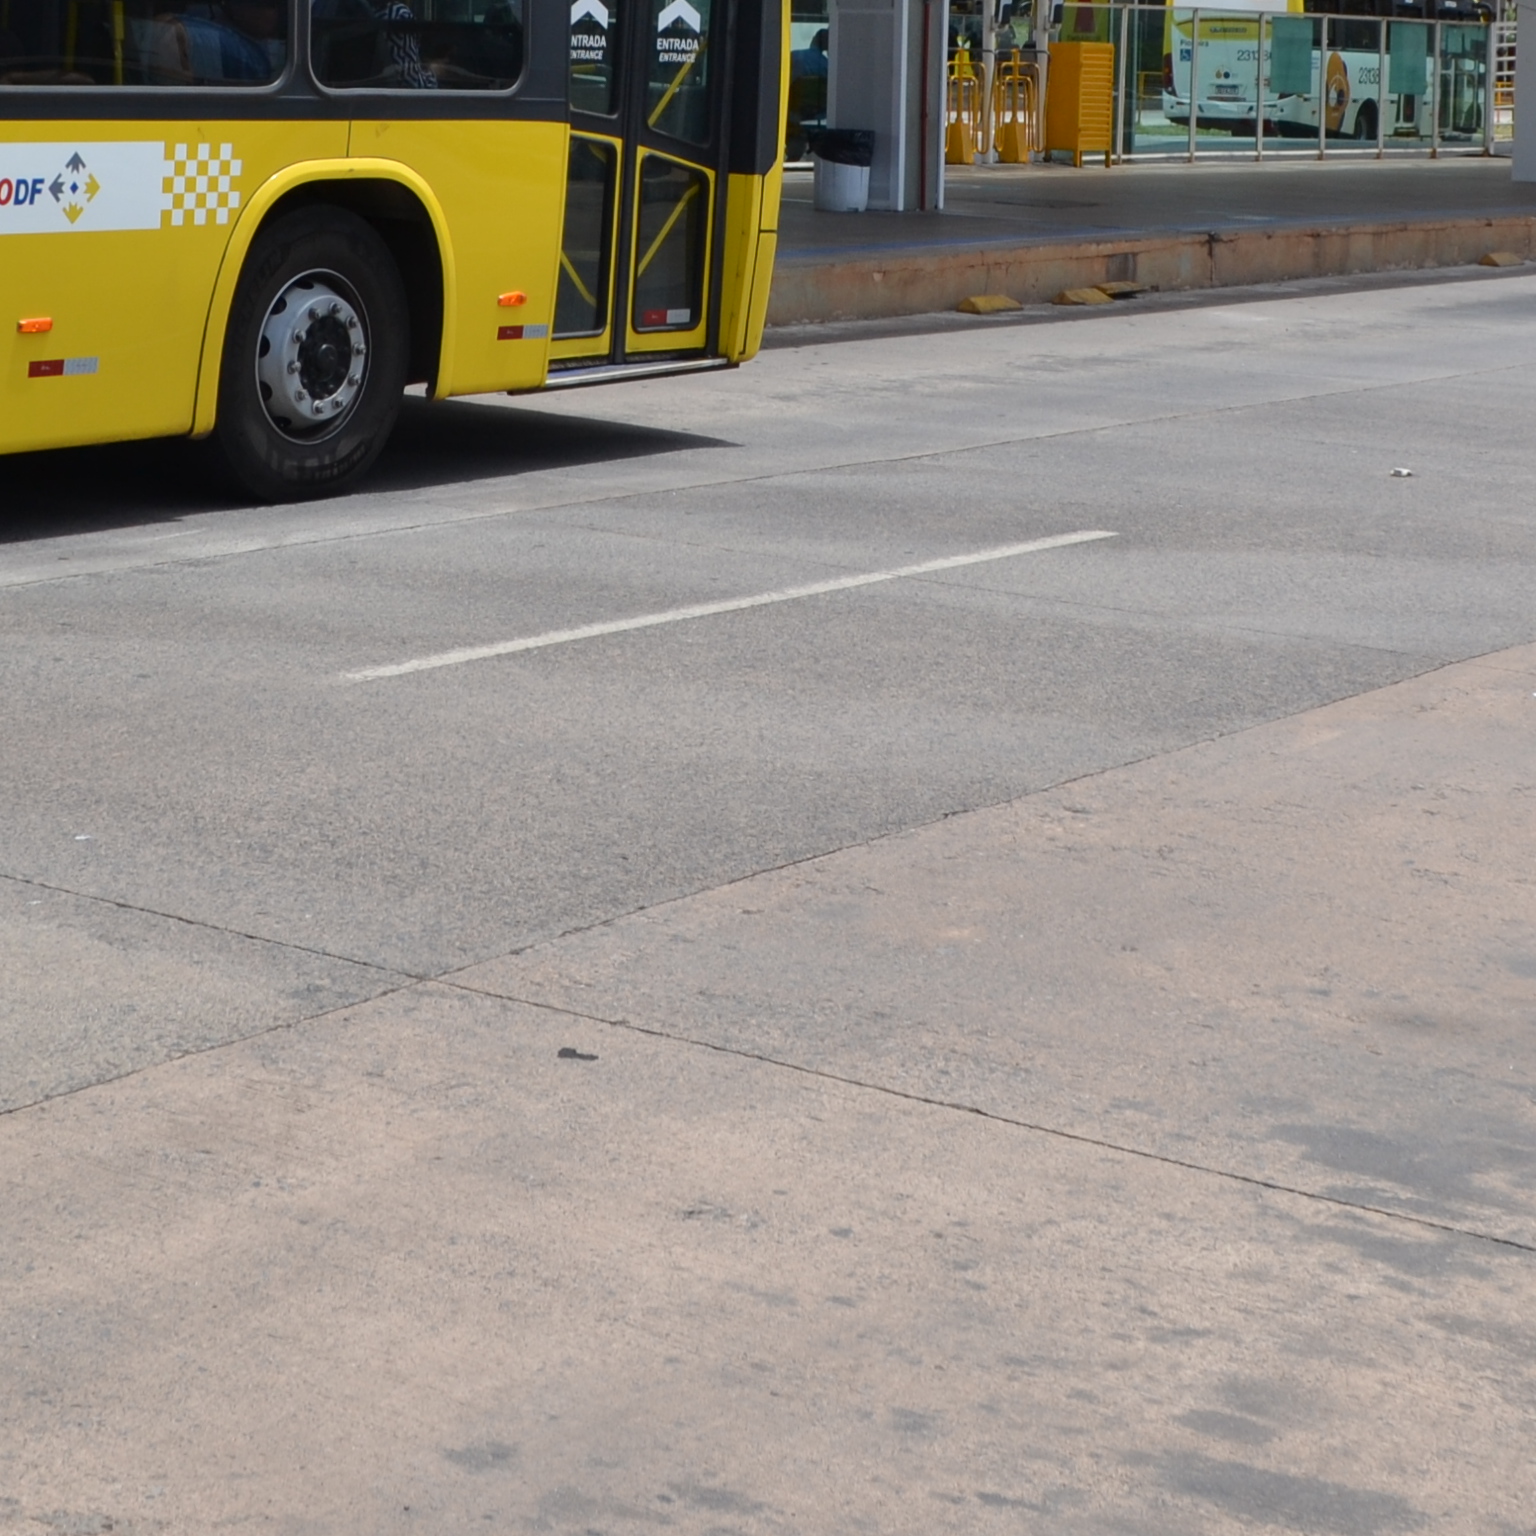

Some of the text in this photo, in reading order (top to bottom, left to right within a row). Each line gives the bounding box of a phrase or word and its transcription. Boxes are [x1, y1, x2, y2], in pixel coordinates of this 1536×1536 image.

[571, 34, 607, 48] NTRADA
[656, 38, 699, 51] ENTRADA
[659, 52, 696, 63] ENTRANCE
